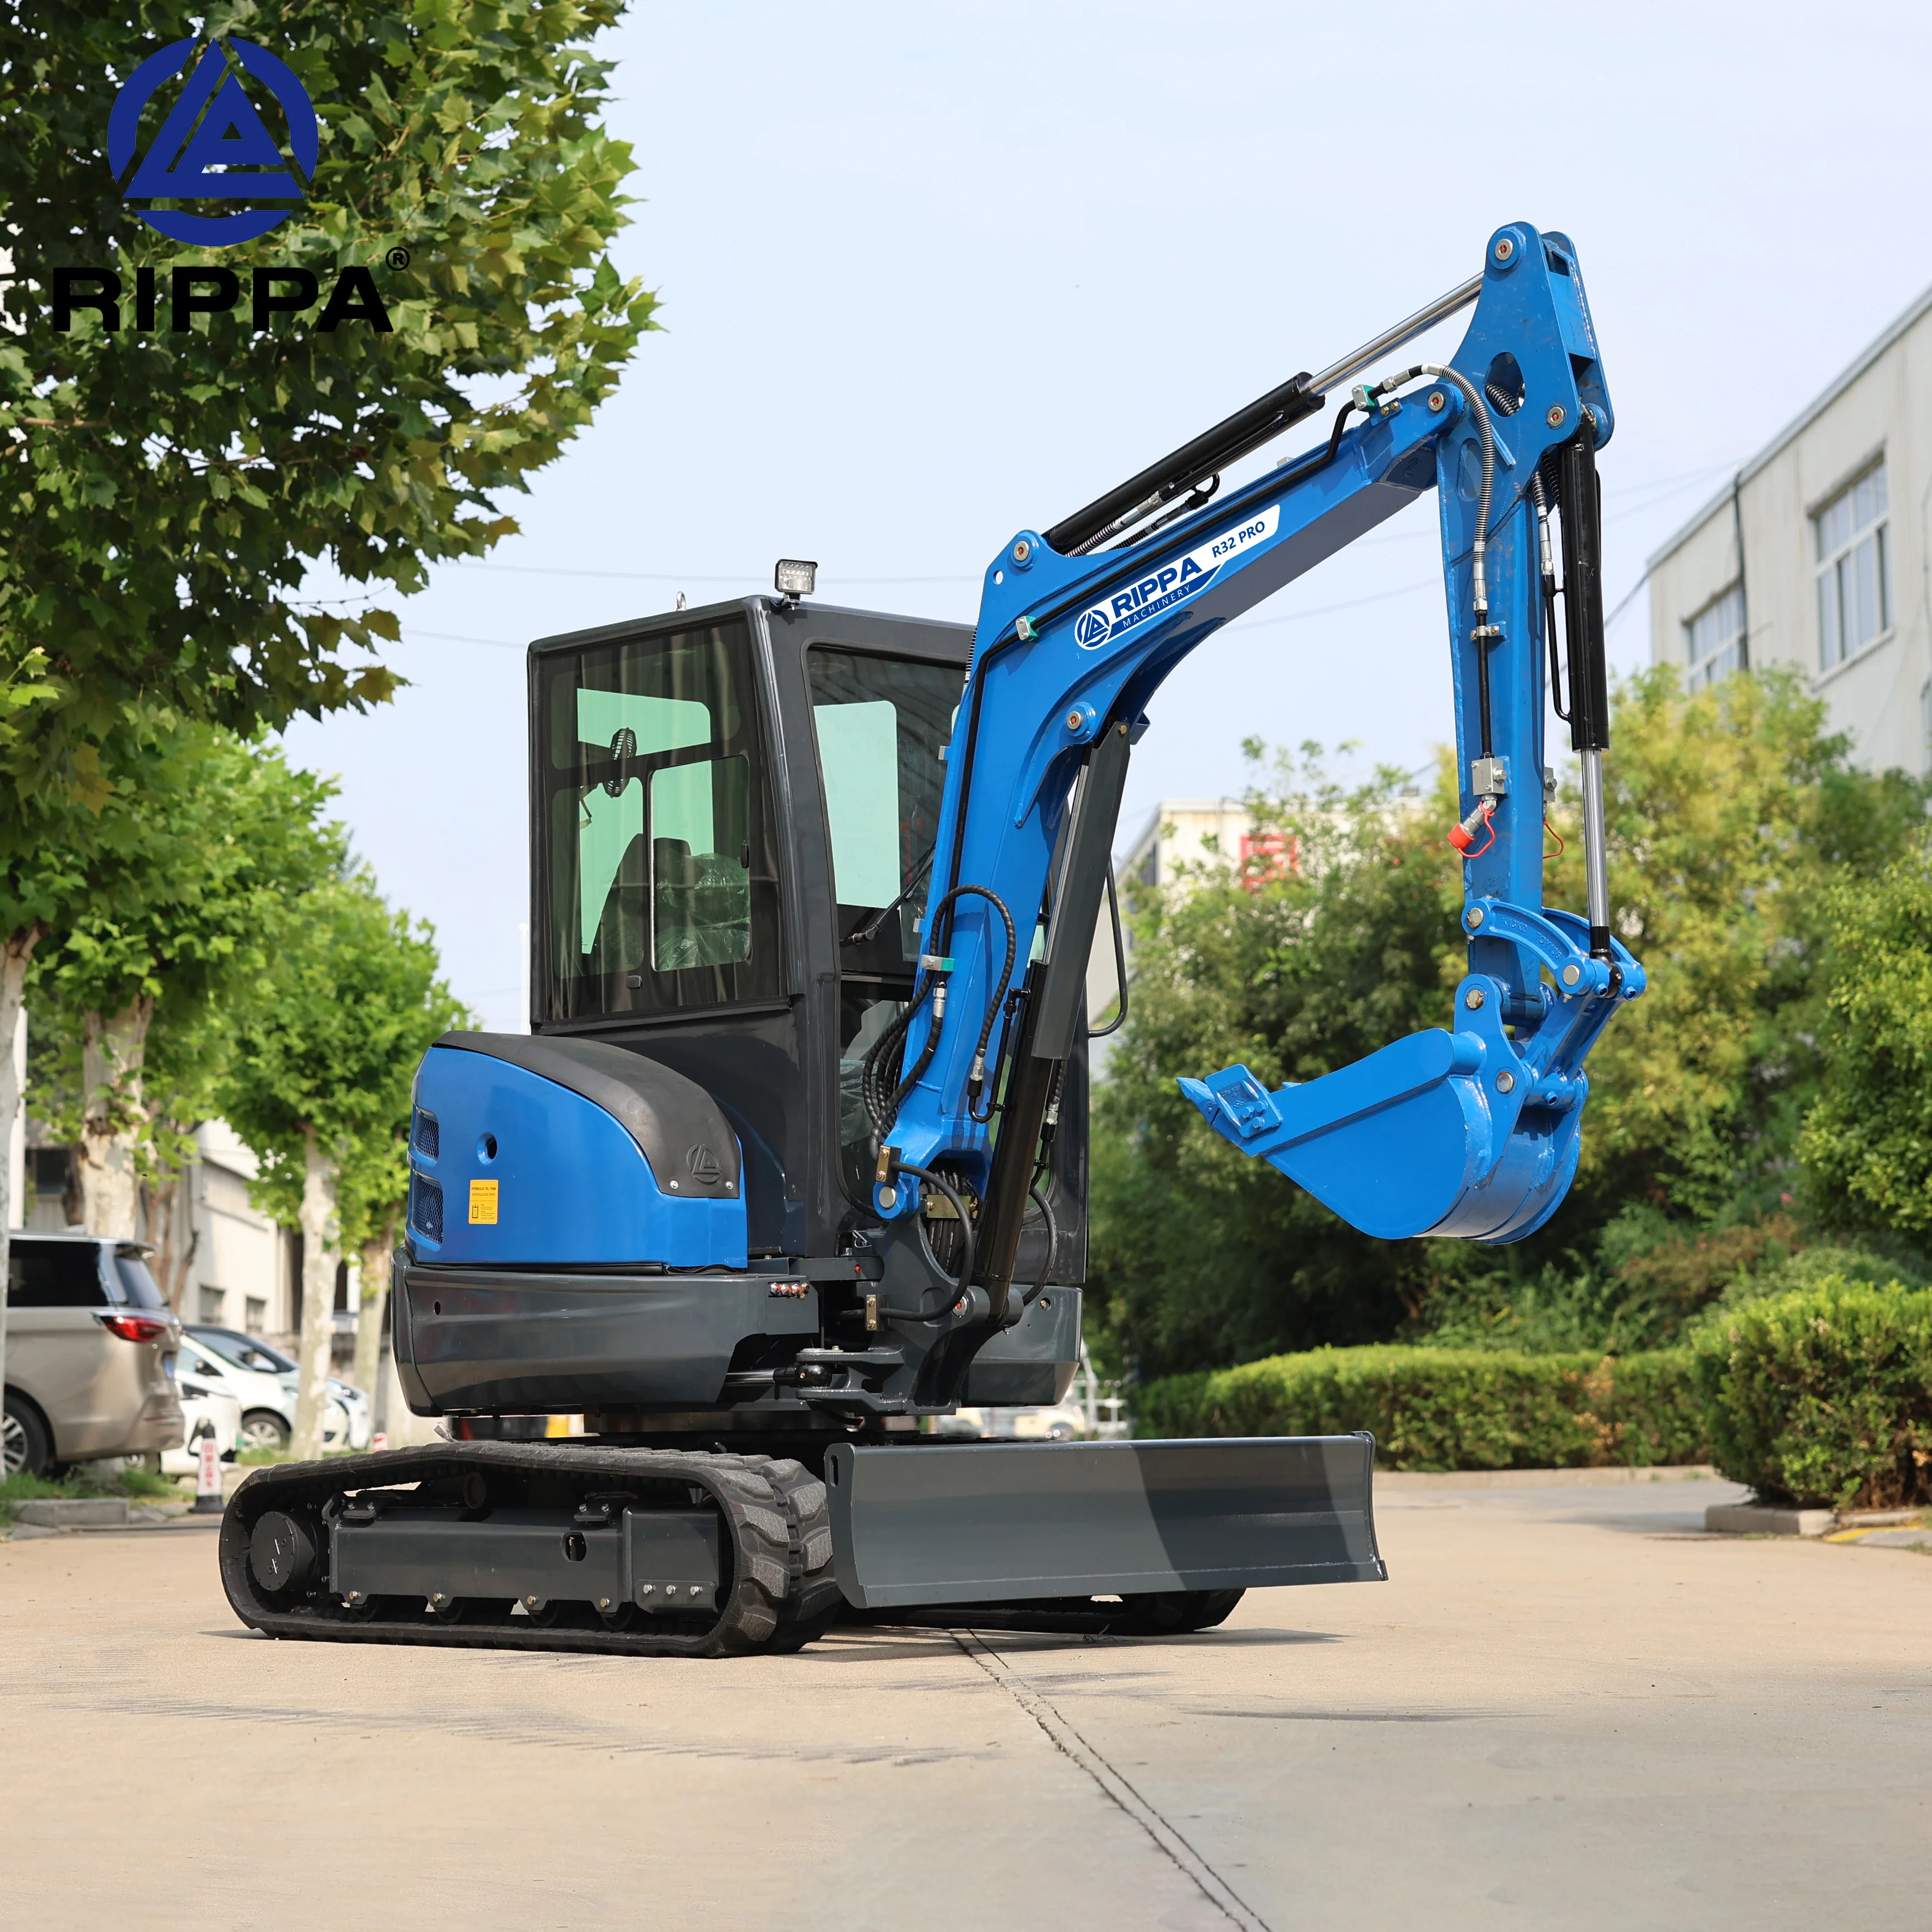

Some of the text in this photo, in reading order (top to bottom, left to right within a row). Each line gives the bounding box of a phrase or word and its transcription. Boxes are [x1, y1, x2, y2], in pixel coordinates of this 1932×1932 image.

[1212, 521, 1265, 558] R32 PRO
[1111, 556, 1203, 619] RIPPA
[1123, 585, 1190, 628] MACHINERY
